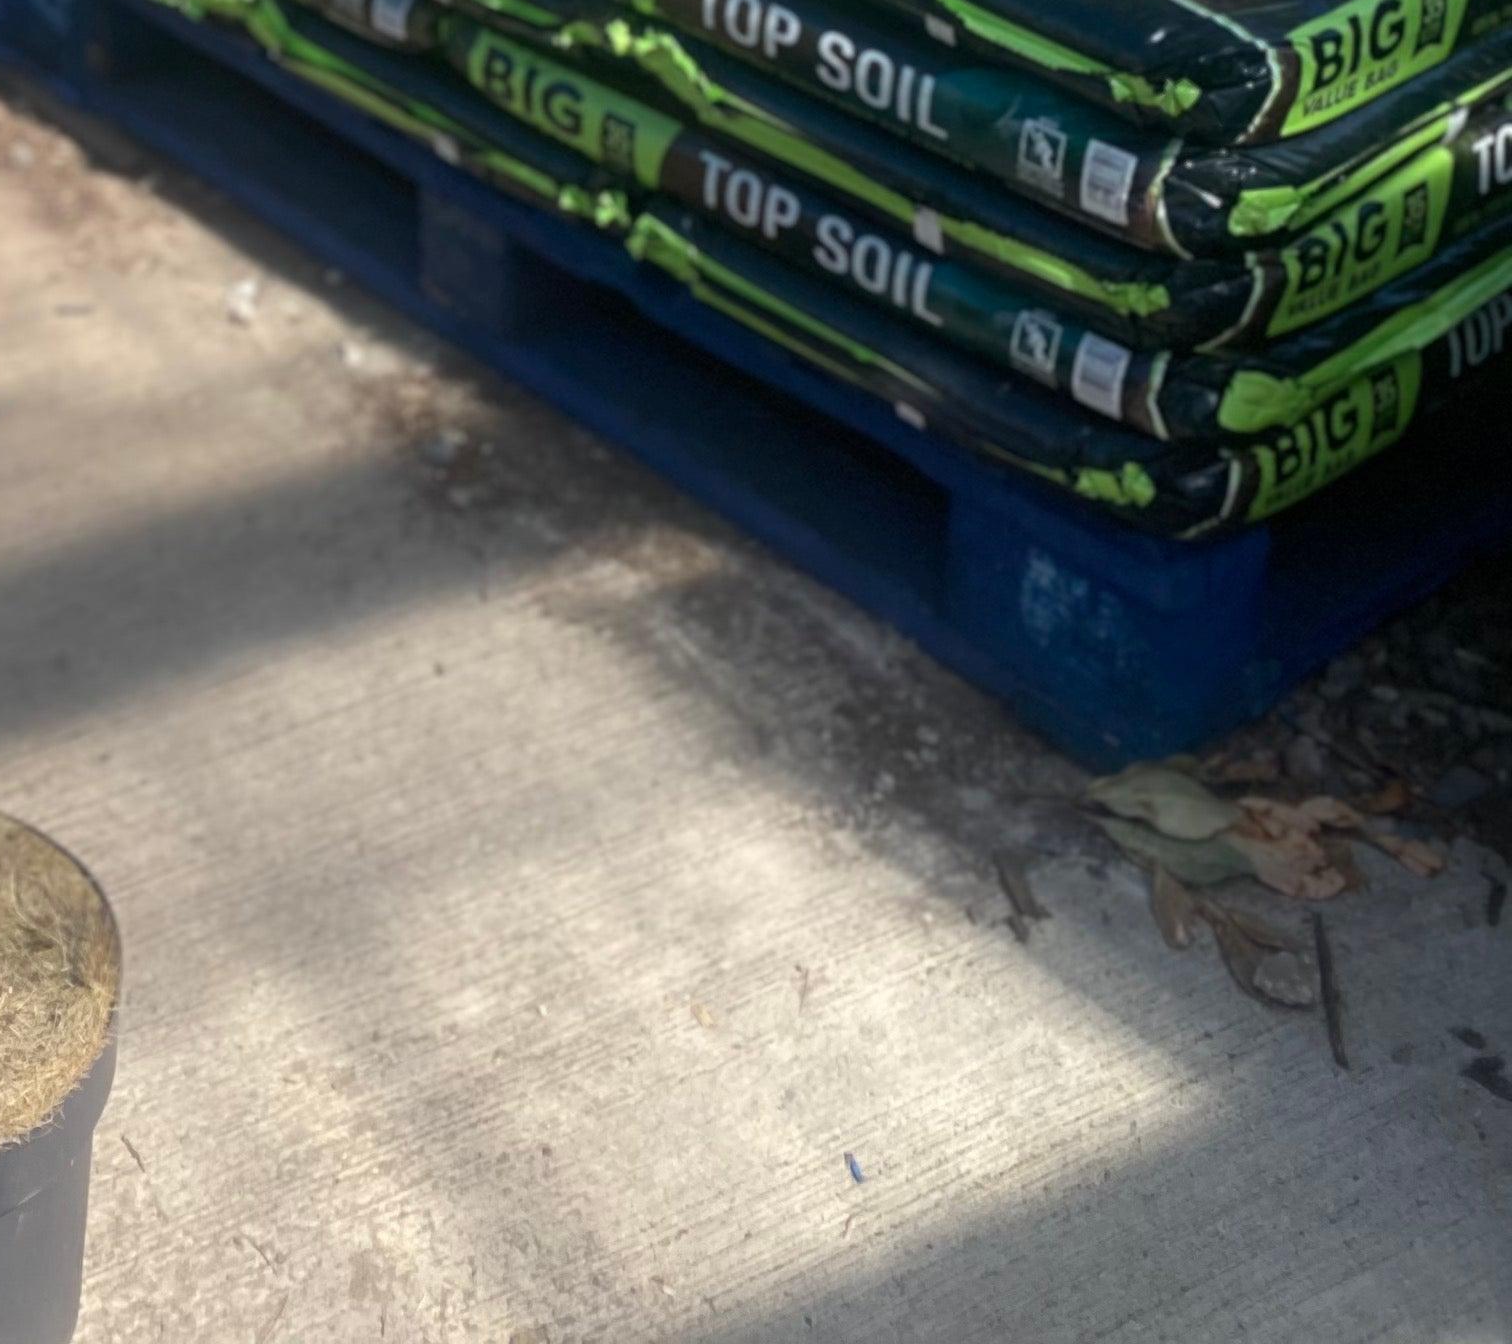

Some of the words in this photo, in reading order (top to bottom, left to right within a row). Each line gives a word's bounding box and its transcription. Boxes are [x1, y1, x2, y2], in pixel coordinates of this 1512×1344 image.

[485, 48, 583, 135] BIG
[816, 30, 948, 140] SOIL
[698, 150, 802, 239] TOP
[813, 214, 944, 328] SOIL
[1296, 201, 1387, 293] BIG
[1275, 387, 1360, 484] BIG
